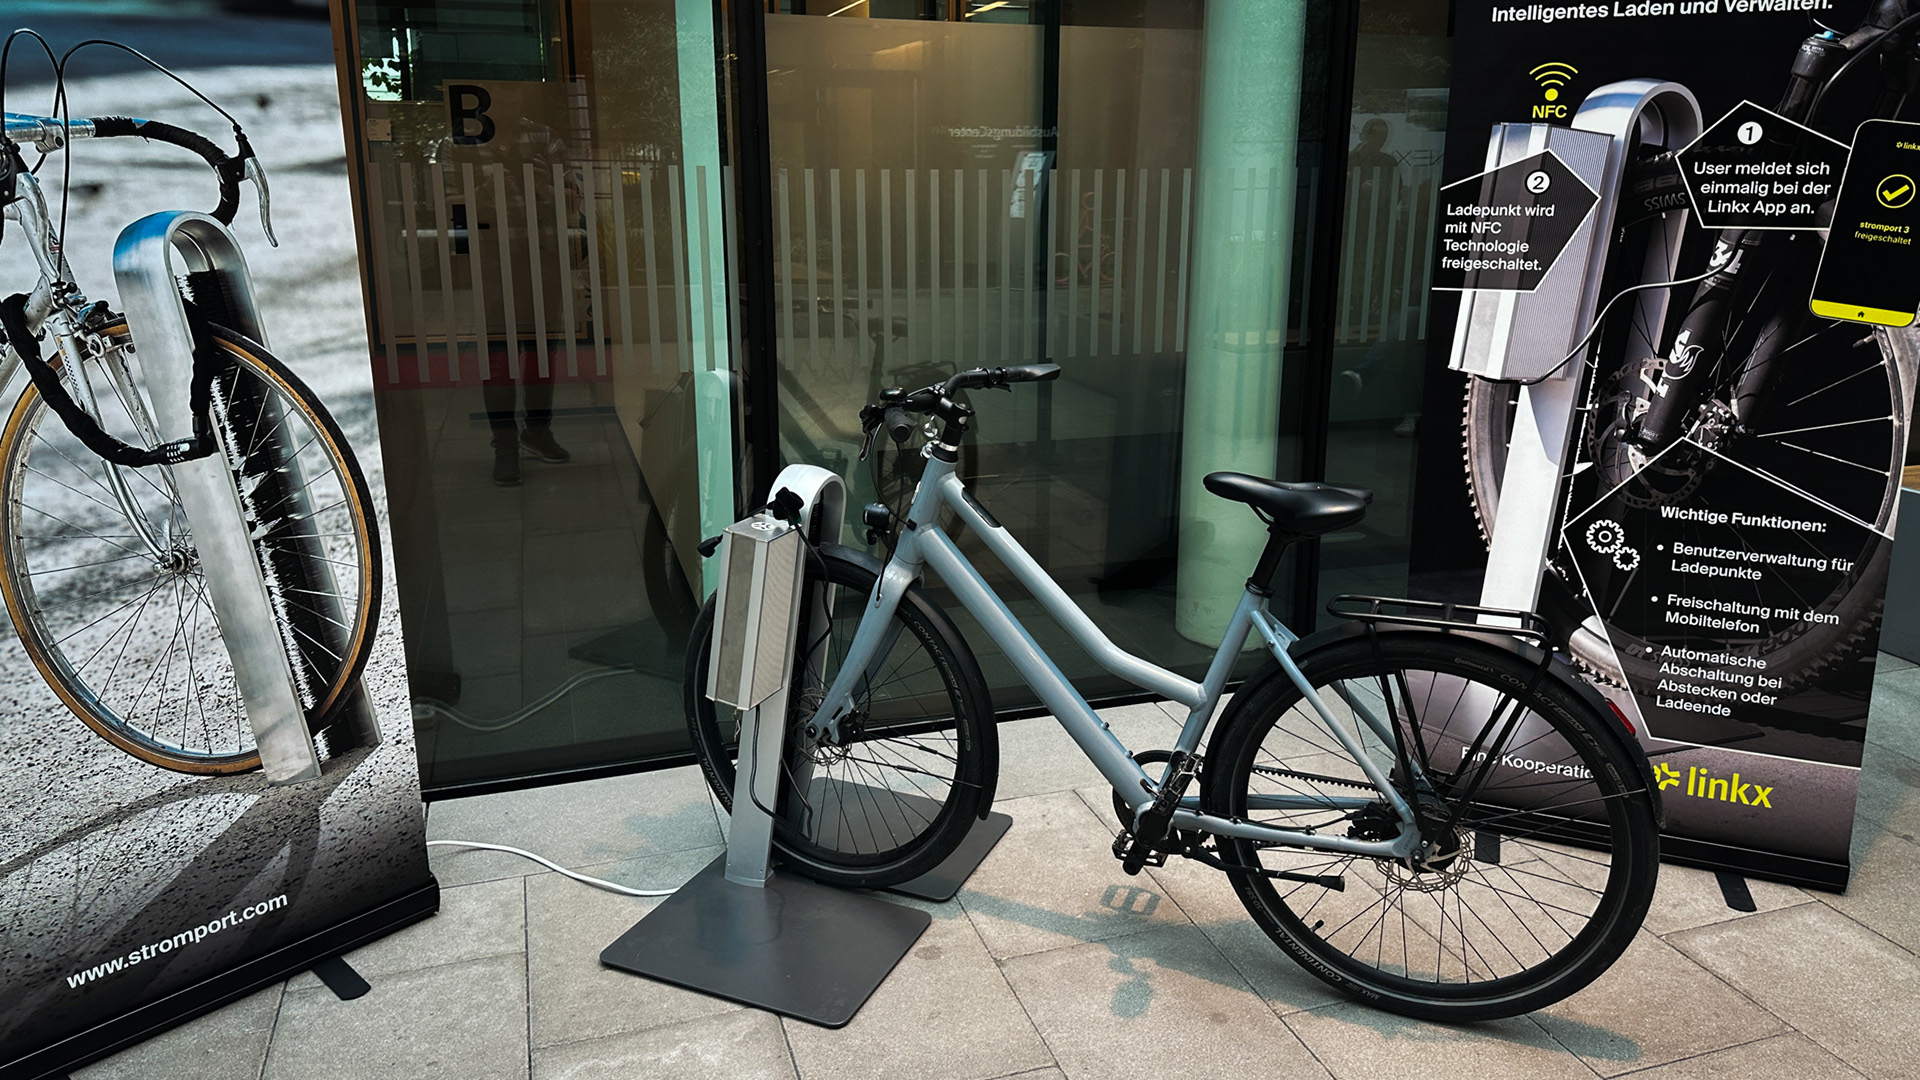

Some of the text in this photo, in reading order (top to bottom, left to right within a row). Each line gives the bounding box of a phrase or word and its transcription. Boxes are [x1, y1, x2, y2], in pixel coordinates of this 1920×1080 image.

[1492, 0, 1833, 24] Intelligentes Laden und Verwalten.
[447, 83, 497, 146] B
[1532, 104, 1568, 119] NFC
[1745, 126, 1754, 141] 1
[1694, 161, 1830, 175] User meldet sich
[1532, 175, 1545, 190] 2
[1700, 180, 1832, 197] einmalig bei der
[1447, 203, 1555, 219] Ladepunkt wird
[1708, 199, 1815, 217] Linkx App an.
[1445, 221, 1502, 234] mit NFC
[1854, 230, 1912, 246] freigeschaltet
[1859, 221, 1910, 234] stromport 3
[1443, 238, 1530, 255] Technologie
[1441, 256, 1542, 272] freigeschaltet.
[1660, 505, 1827, 533] Wichtige Funktionen:
[1671, 542, 1854, 574] Benutzerverwaltung für
[1671, 558, 1763, 581] Ladepunkte
[1665, 593, 1840, 625] Freischaltung mit dem
[1665, 609, 1760, 634] Mobiltelefon
[1660, 645, 1767, 671] Automatische
[1657, 660, 1783, 689] Abschaltung bei
[1498, 672, 1560, 711] CONACT
[1656, 678, 1778, 706] Abstecken oder
[1656, 695, 1731, 717] Ladeende
[1460, 746, 1595, 780] Ein Kooperatio
[701, 754, 733, 809] ONTINENTAL
[1686, 765, 1774, 809] linkx
[66, 893, 288, 990] www.stromport.com
[1274, 926, 1343, 983] CONTINENTAL
